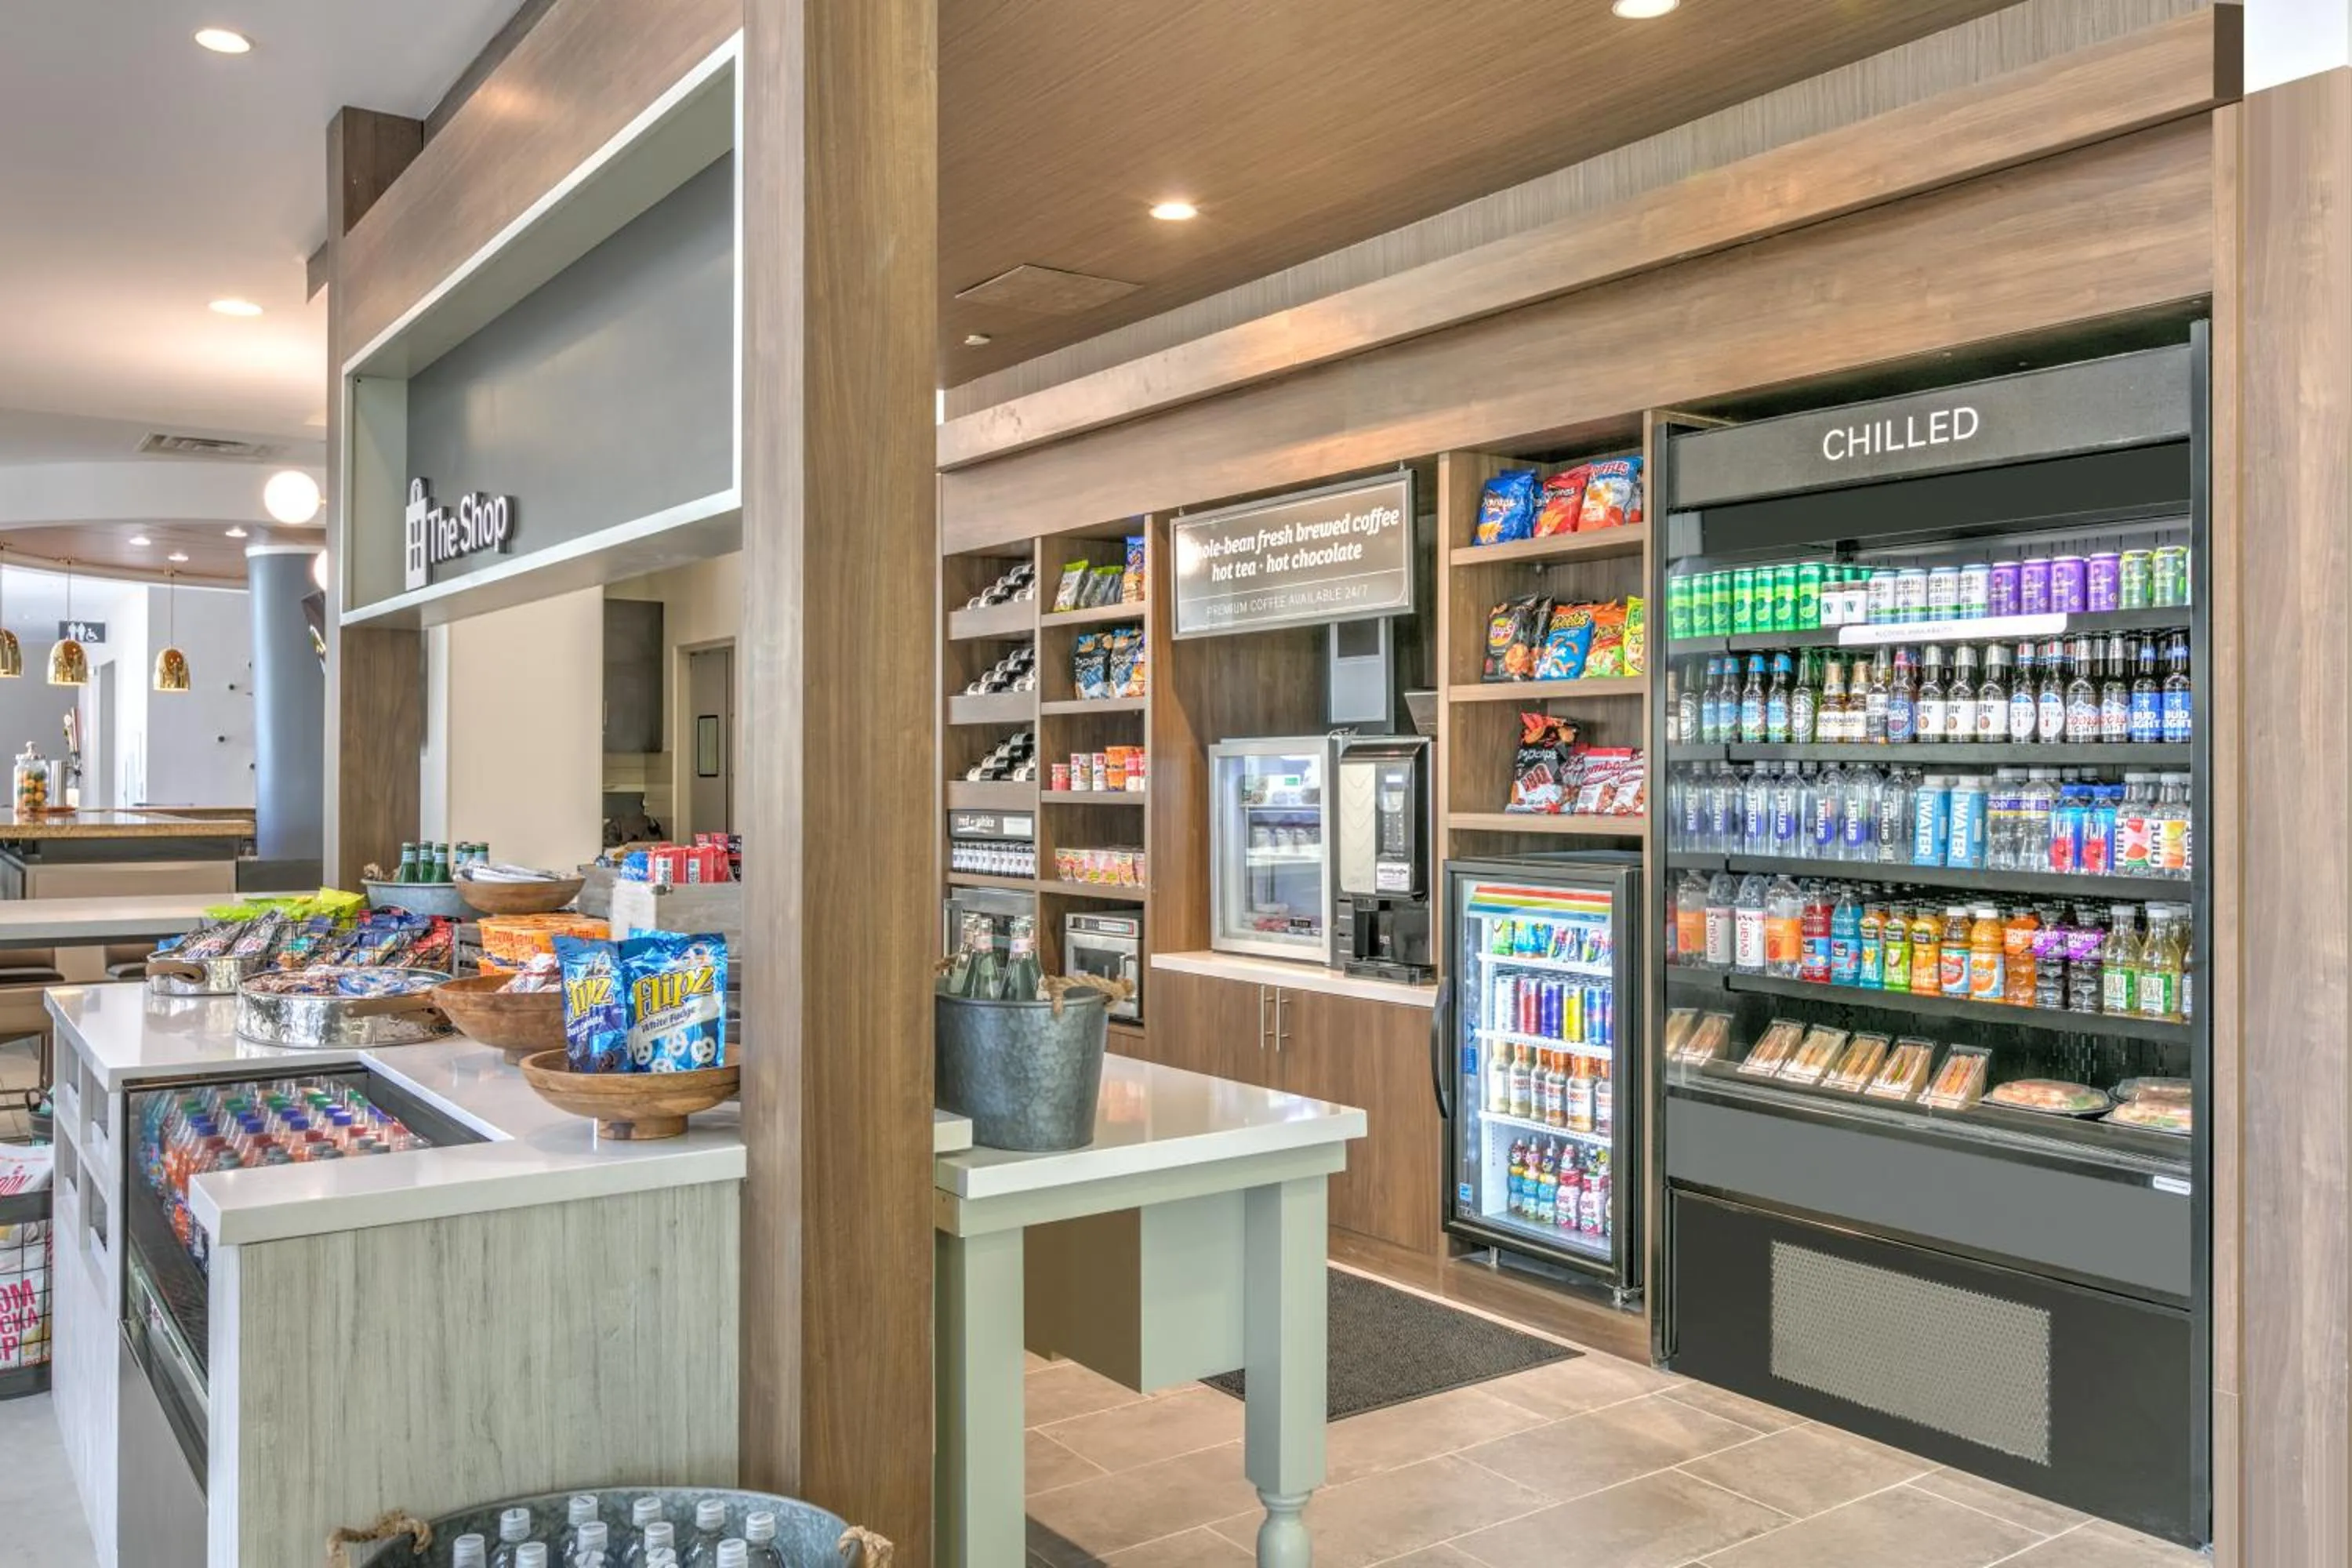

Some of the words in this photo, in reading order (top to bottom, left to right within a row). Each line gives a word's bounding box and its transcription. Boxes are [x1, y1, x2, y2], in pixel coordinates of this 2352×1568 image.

[1821, 406, 1980, 461] CHILLED
[426, 506, 459, 564] The
[459, 492, 510, 554] Shop
[1254, 524, 1294, 555] fresh
[1295, 512, 1352, 543] brewed
[1352, 506, 1400, 535] coffee
[1211, 562, 1234, 583] hot
[1235, 560, 1258, 579] tea
[1266, 553, 1290, 573] hot
[1290, 542, 1363, 569] chocolate
[1250, 596, 1286, 613] COFFEE
[1288, 587, 1343, 606] AVAILABLE
[1344, 584, 1369, 601] 24/7
[1918, 796, 1933, 856] WATER
[1951, 798, 1969, 859] WATER
[1738, 920, 1750, 958] evian
[641, 1016, 669, 1034] White
